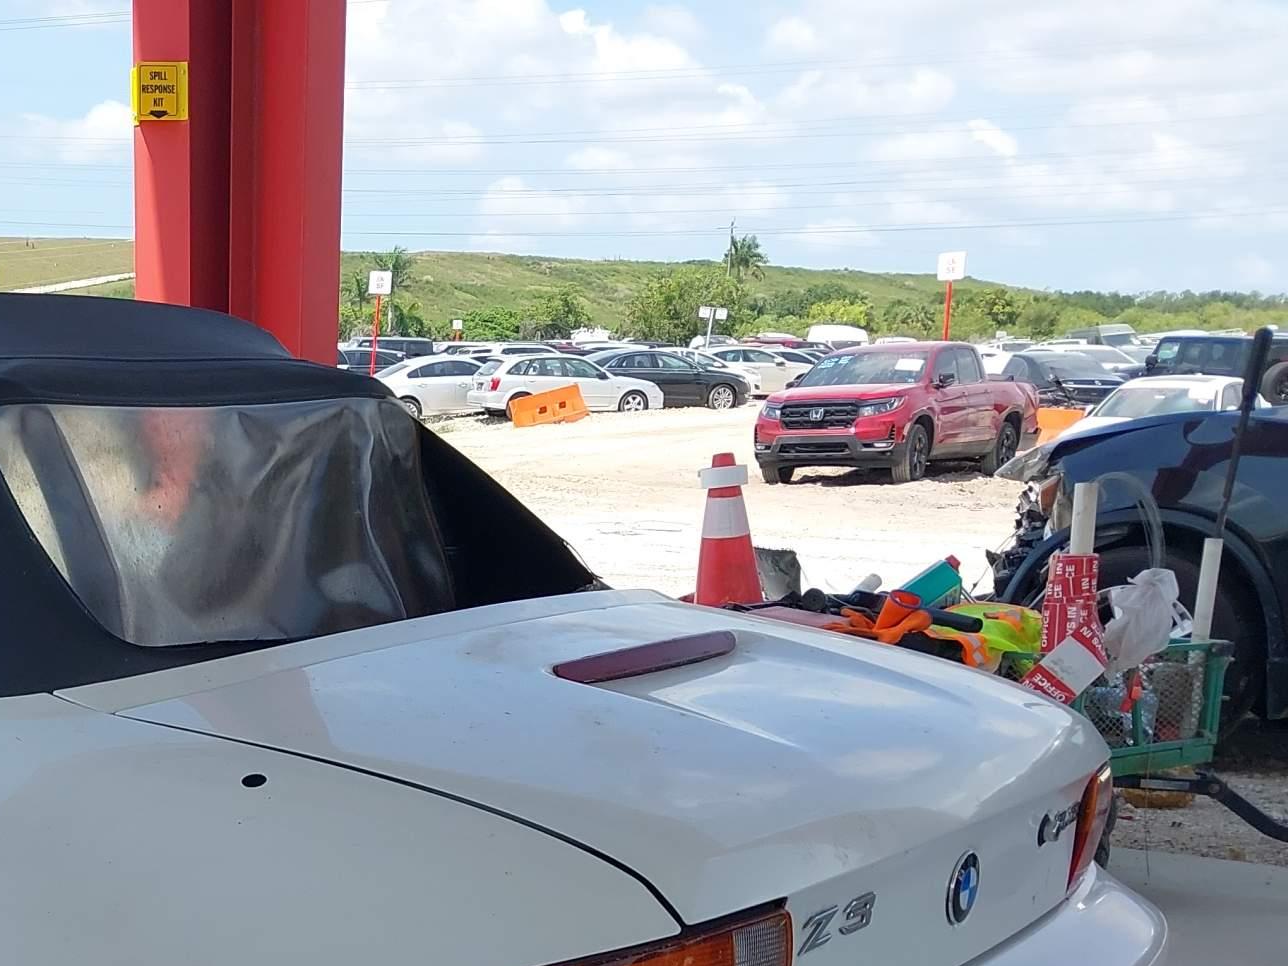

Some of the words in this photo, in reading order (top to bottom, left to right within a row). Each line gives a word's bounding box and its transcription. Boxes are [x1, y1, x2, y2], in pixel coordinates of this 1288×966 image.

[149, 71, 168, 81] SPILL
[141, 84, 176, 94] RESPONSE
[153, 97, 164, 108] KIT
[1041, 609, 1050, 648] OFFICE
[1032, 672, 1066, 702] OFFICE
[797, 891, 877, 957] Z3
